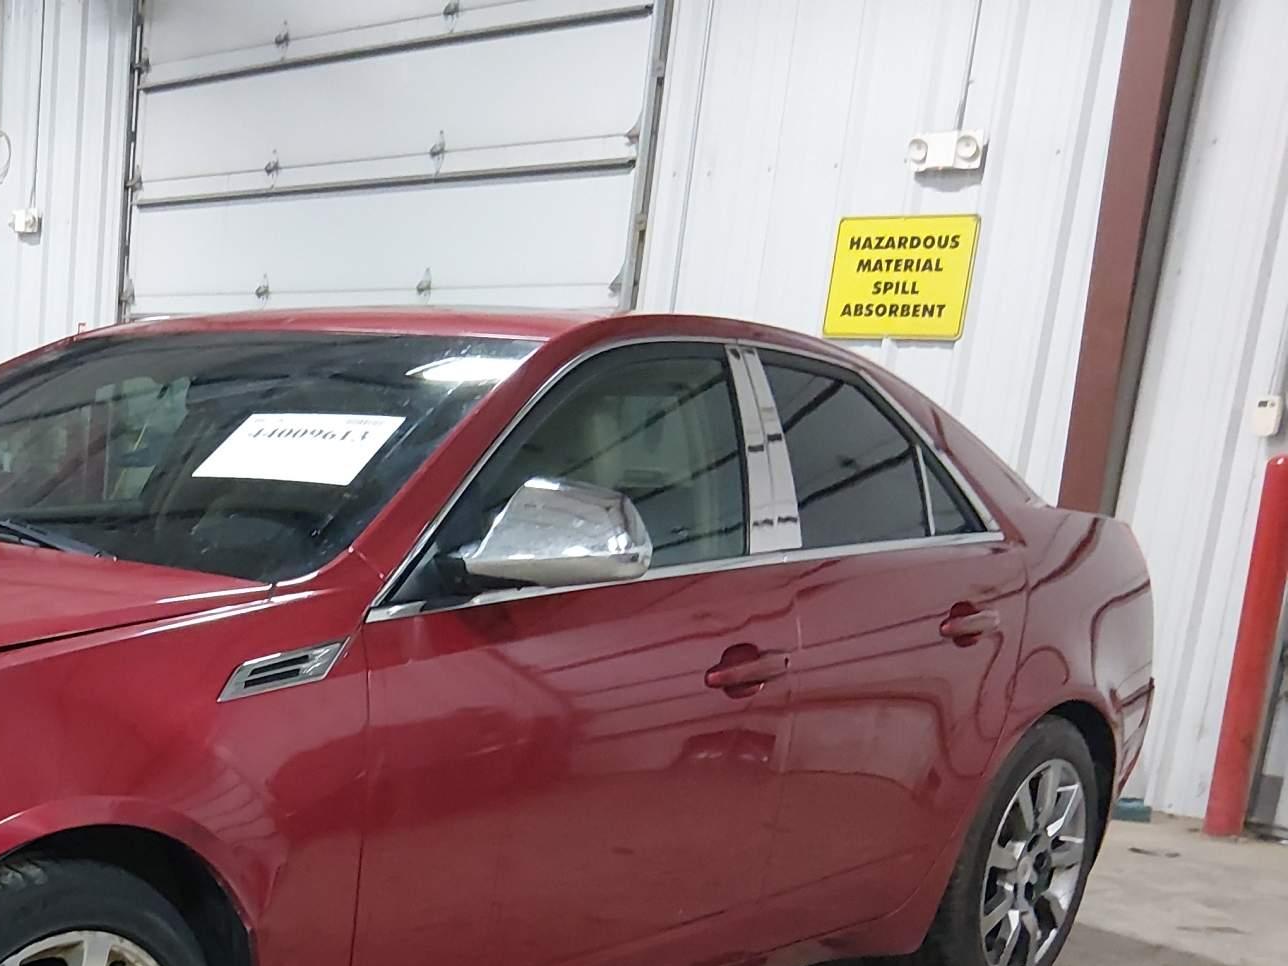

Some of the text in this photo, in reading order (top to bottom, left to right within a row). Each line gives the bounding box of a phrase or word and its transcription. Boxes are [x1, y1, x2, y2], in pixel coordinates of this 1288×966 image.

[849, 234, 961, 251] HAZARDOUS
[856, 258, 944, 273] MATERIAL
[871, 281, 920, 296] SPILL
[840, 303, 946, 318] ABSORBENT
